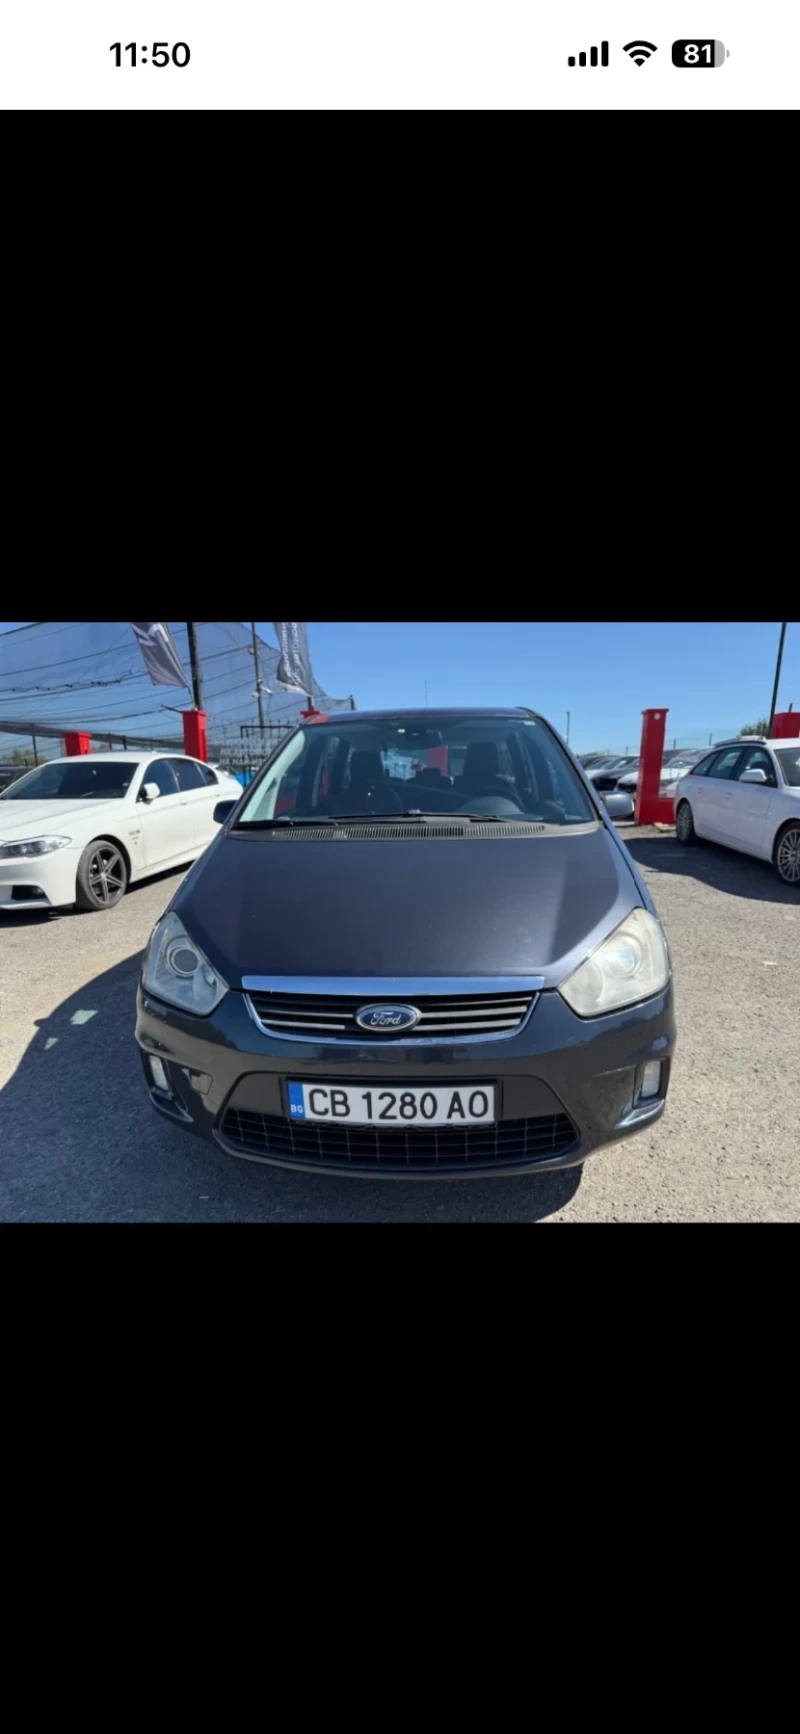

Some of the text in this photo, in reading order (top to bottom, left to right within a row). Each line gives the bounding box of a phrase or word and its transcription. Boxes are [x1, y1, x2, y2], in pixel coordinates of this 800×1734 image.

[370, 1011, 402, 1026] Ford
[290, 1105, 304, 1114] BG
[308, 1088, 489, 1120] CB 1280 AO
